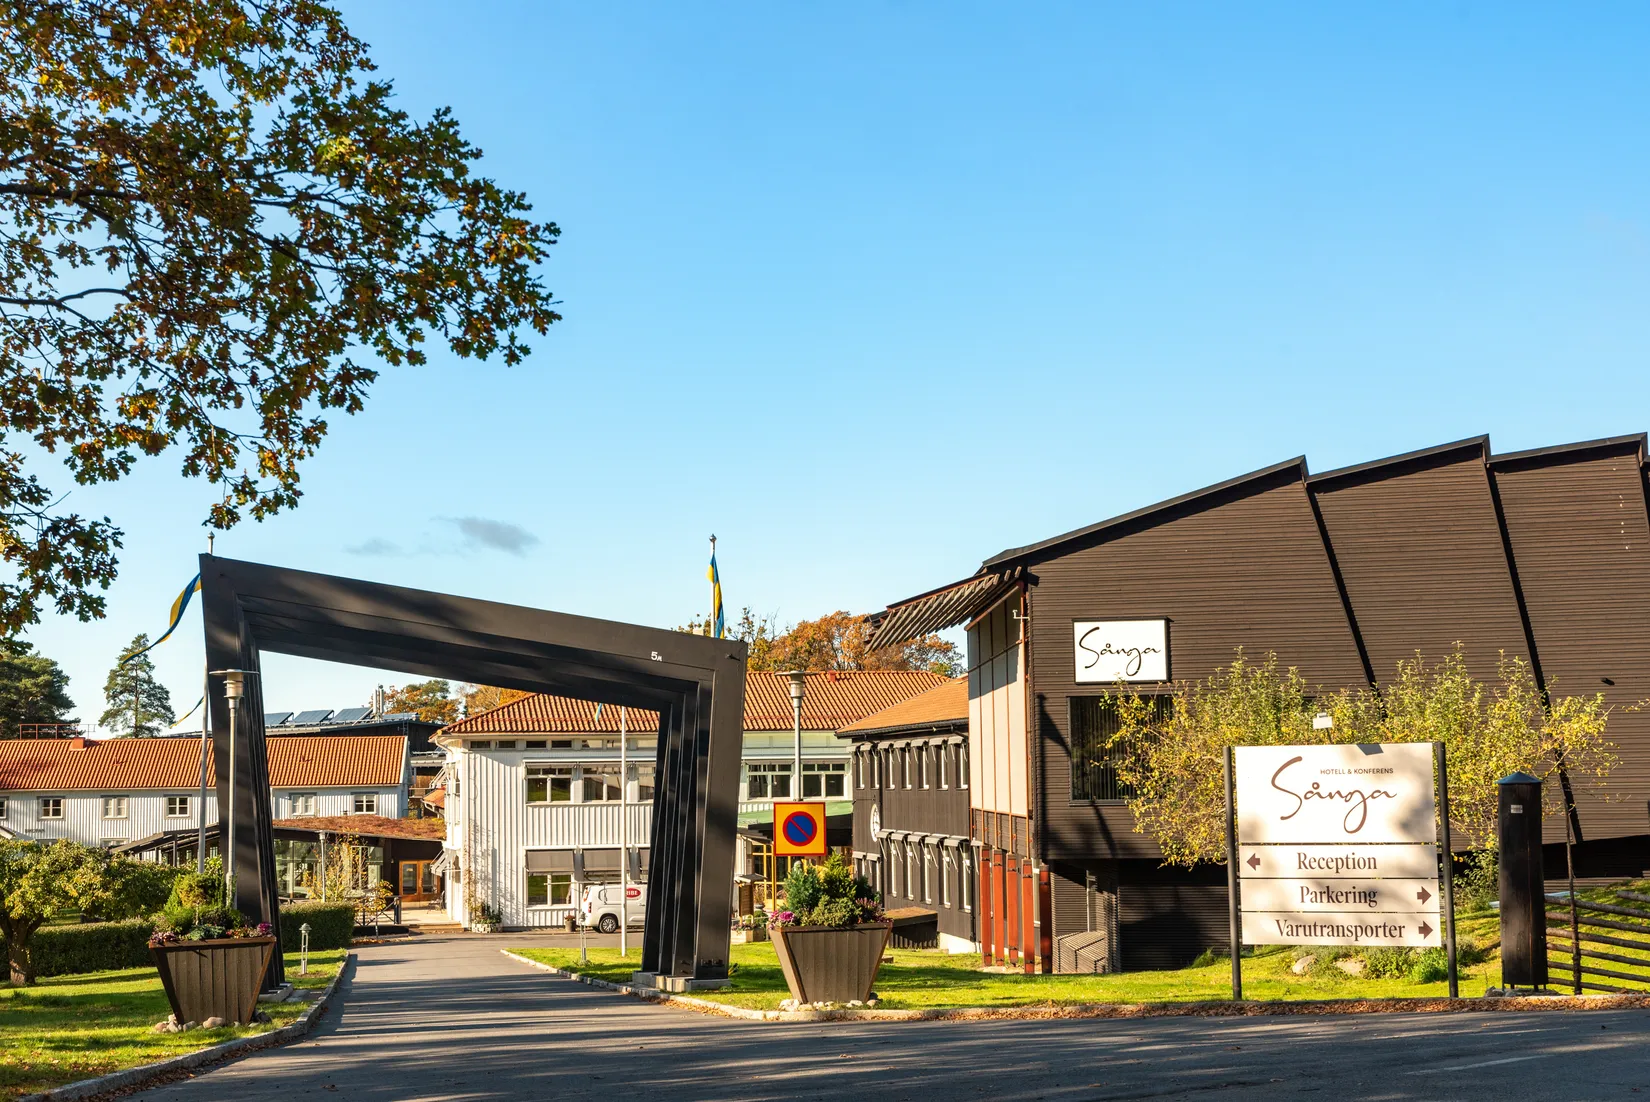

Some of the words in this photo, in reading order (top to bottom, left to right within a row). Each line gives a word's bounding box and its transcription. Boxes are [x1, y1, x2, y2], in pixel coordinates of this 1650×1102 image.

[1079, 626, 1161, 677] Sånga
[1271, 756, 1397, 834] Sånga
[1297, 852, 1378, 874] Reception
[1300, 885, 1378, 908] Parkering
[1275, 919, 1406, 942] Varutransporter
